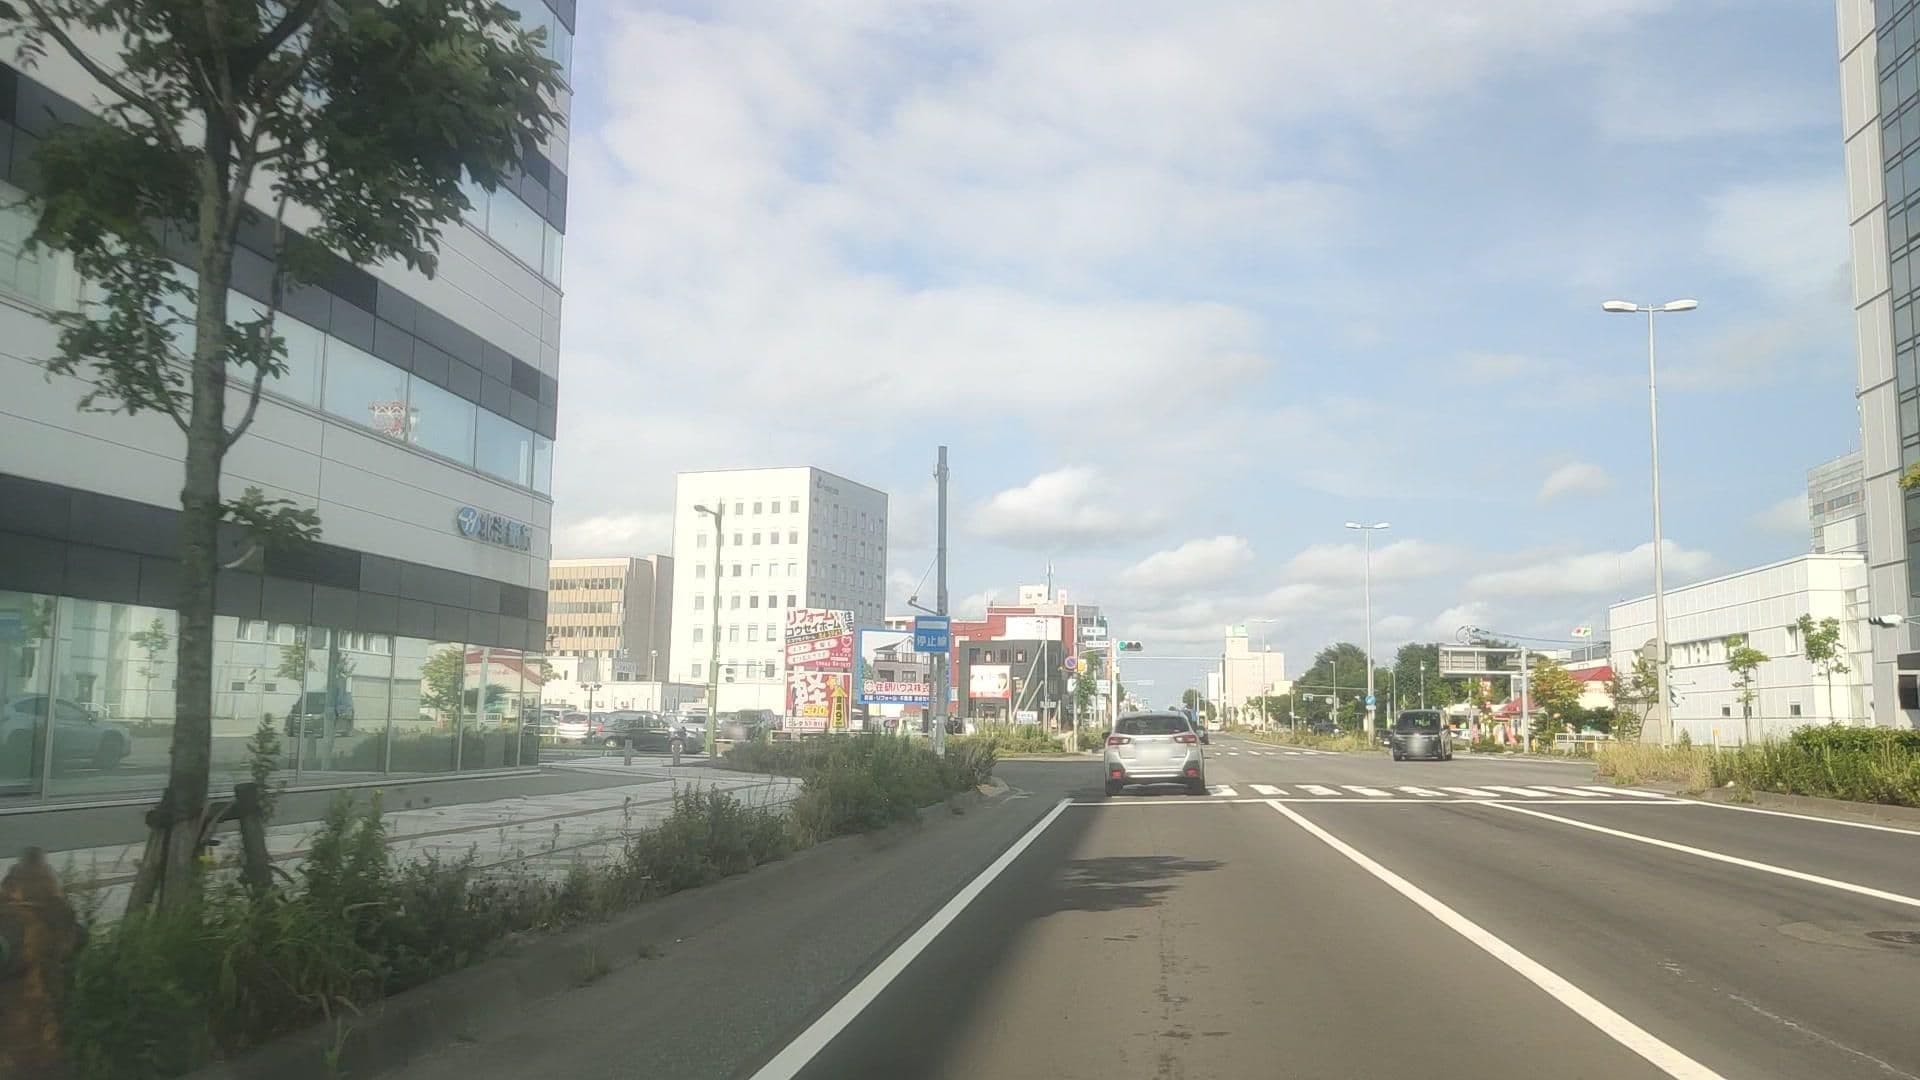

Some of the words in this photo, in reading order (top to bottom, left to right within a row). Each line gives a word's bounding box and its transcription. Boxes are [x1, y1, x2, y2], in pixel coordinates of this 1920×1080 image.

[785, 619, 841, 637] コウセイホーム
[787, 609, 835, 629] リフォーム
